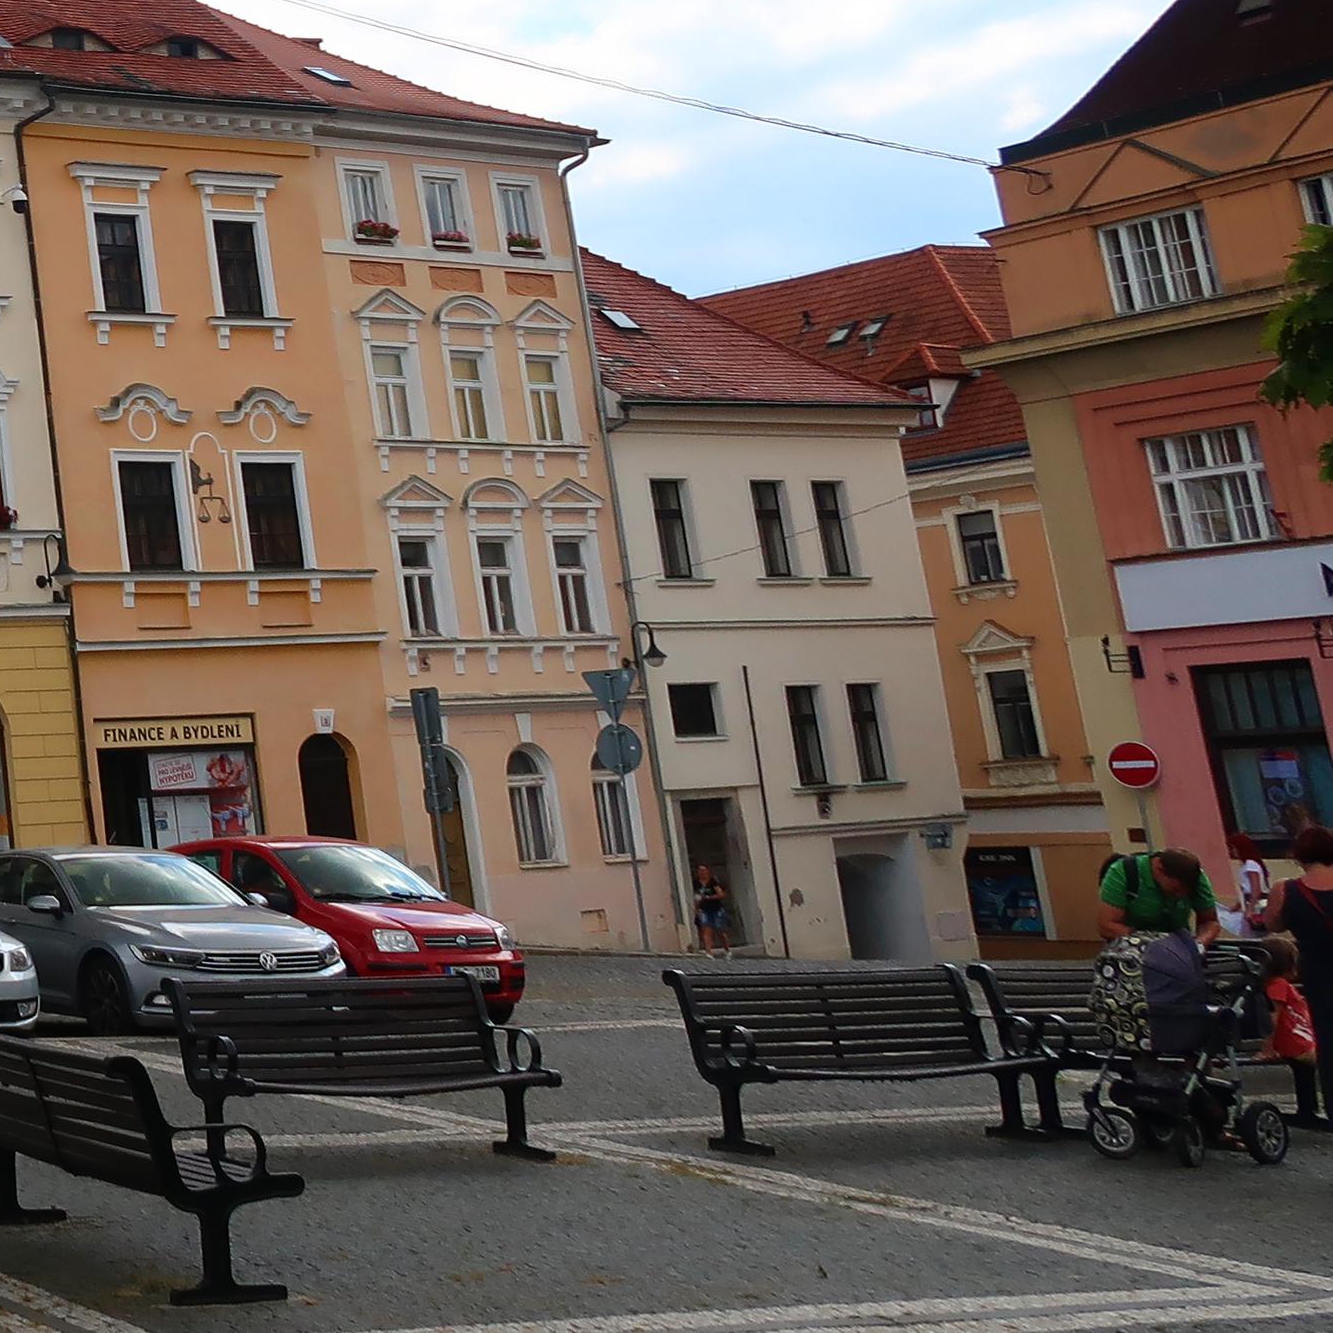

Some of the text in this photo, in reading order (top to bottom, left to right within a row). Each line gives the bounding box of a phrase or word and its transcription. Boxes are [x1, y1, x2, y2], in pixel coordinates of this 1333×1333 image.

[103, 720, 242, 743] FINANCE A BYDLENÍ
